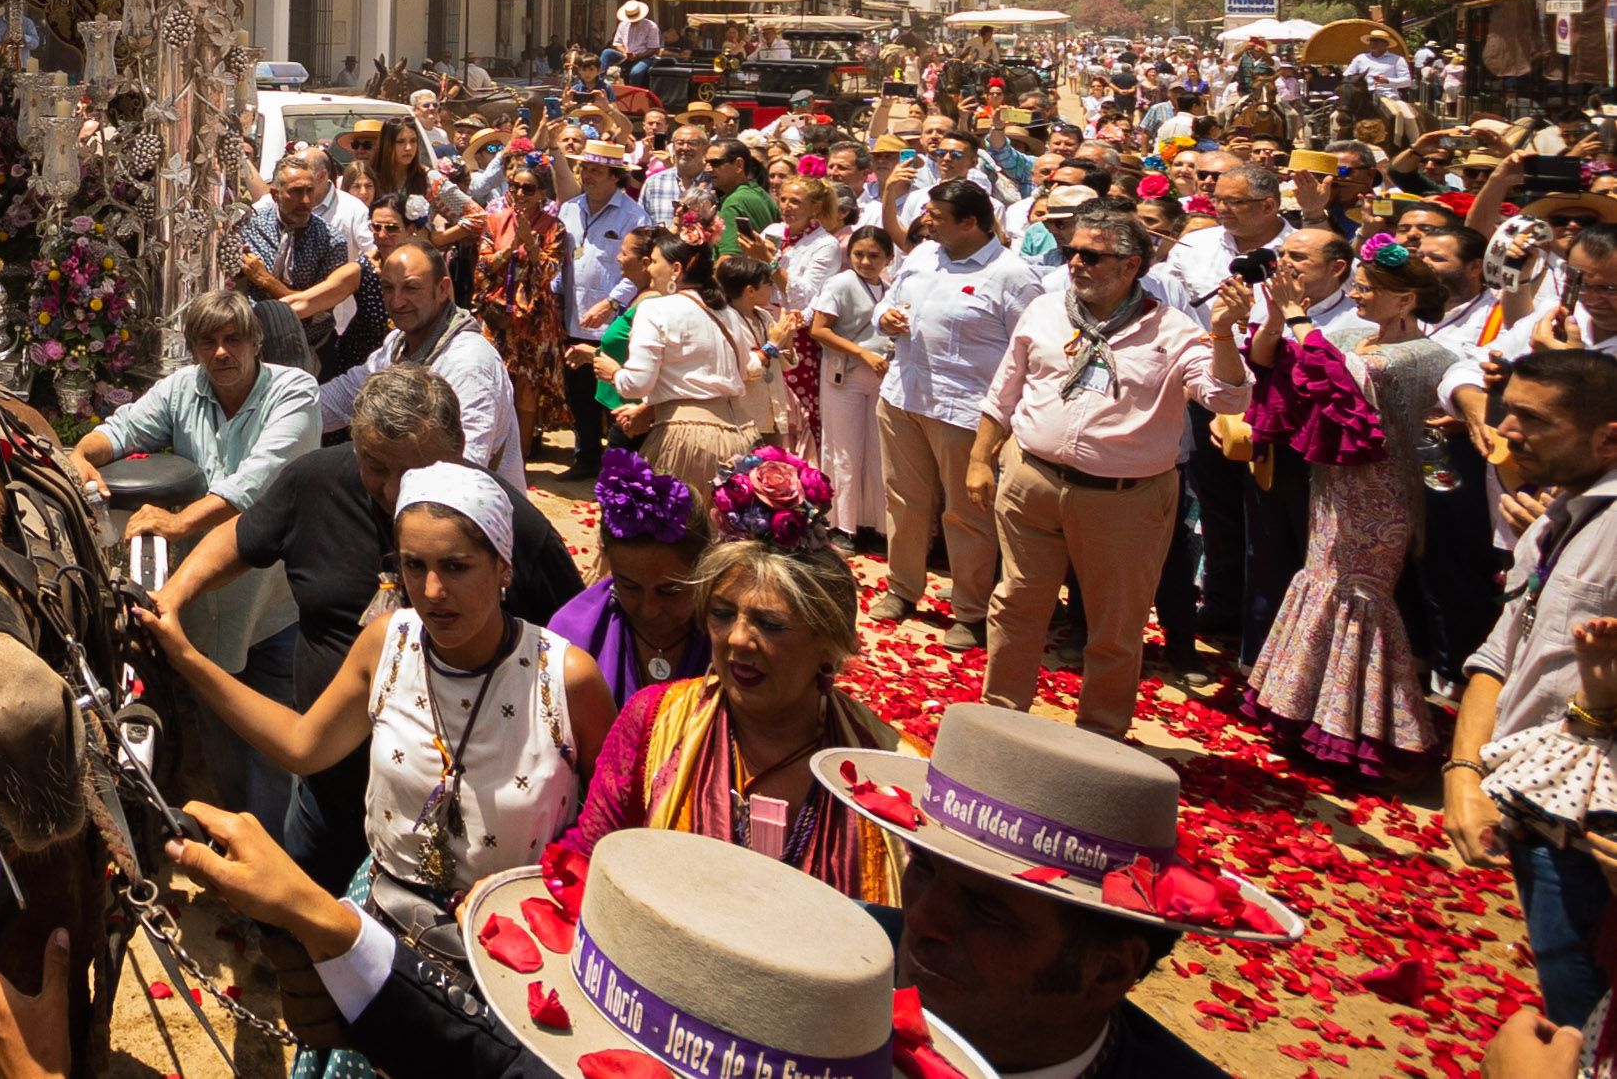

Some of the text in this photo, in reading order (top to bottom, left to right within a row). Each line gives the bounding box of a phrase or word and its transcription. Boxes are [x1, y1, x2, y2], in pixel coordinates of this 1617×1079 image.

[943, 789, 978, 825] Real
[977, 804, 1024, 846] Hdad.
[1032, 826, 1062, 858] del
[584, 950, 605, 1000] del
[604, 969, 645, 1034] Rocío
[664, 1013, 716, 1077] Jerez
[720, 1040, 746, 1079] de
[755, 1052, 772, 1079] la
